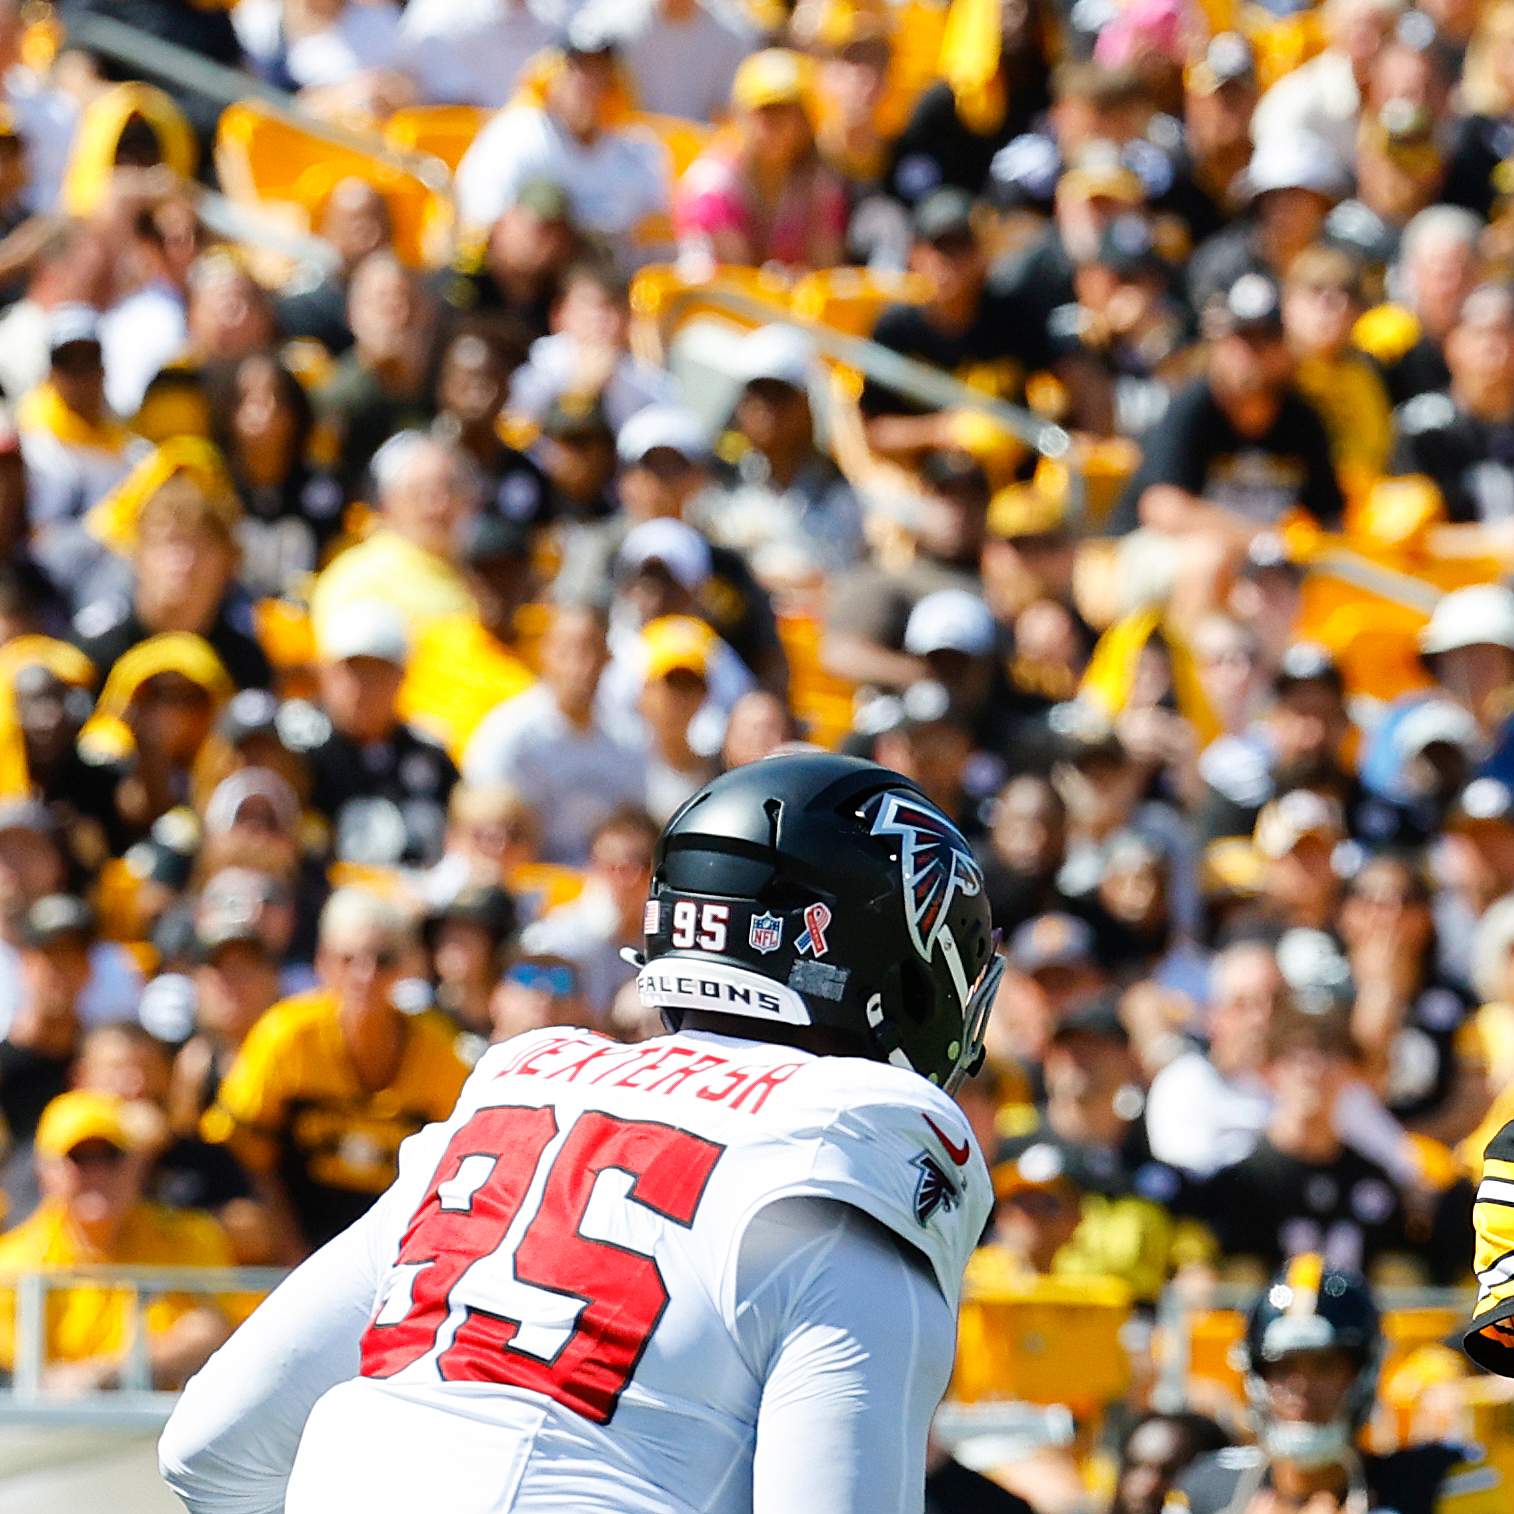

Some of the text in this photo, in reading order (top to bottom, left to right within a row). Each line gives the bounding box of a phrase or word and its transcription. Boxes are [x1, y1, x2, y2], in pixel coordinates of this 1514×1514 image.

[672, 900, 731, 952] 95
[755, 929, 778, 947] NFL
[637, 976, 780, 1013] FALCONS
[359, 1103, 727, 1426] 95
